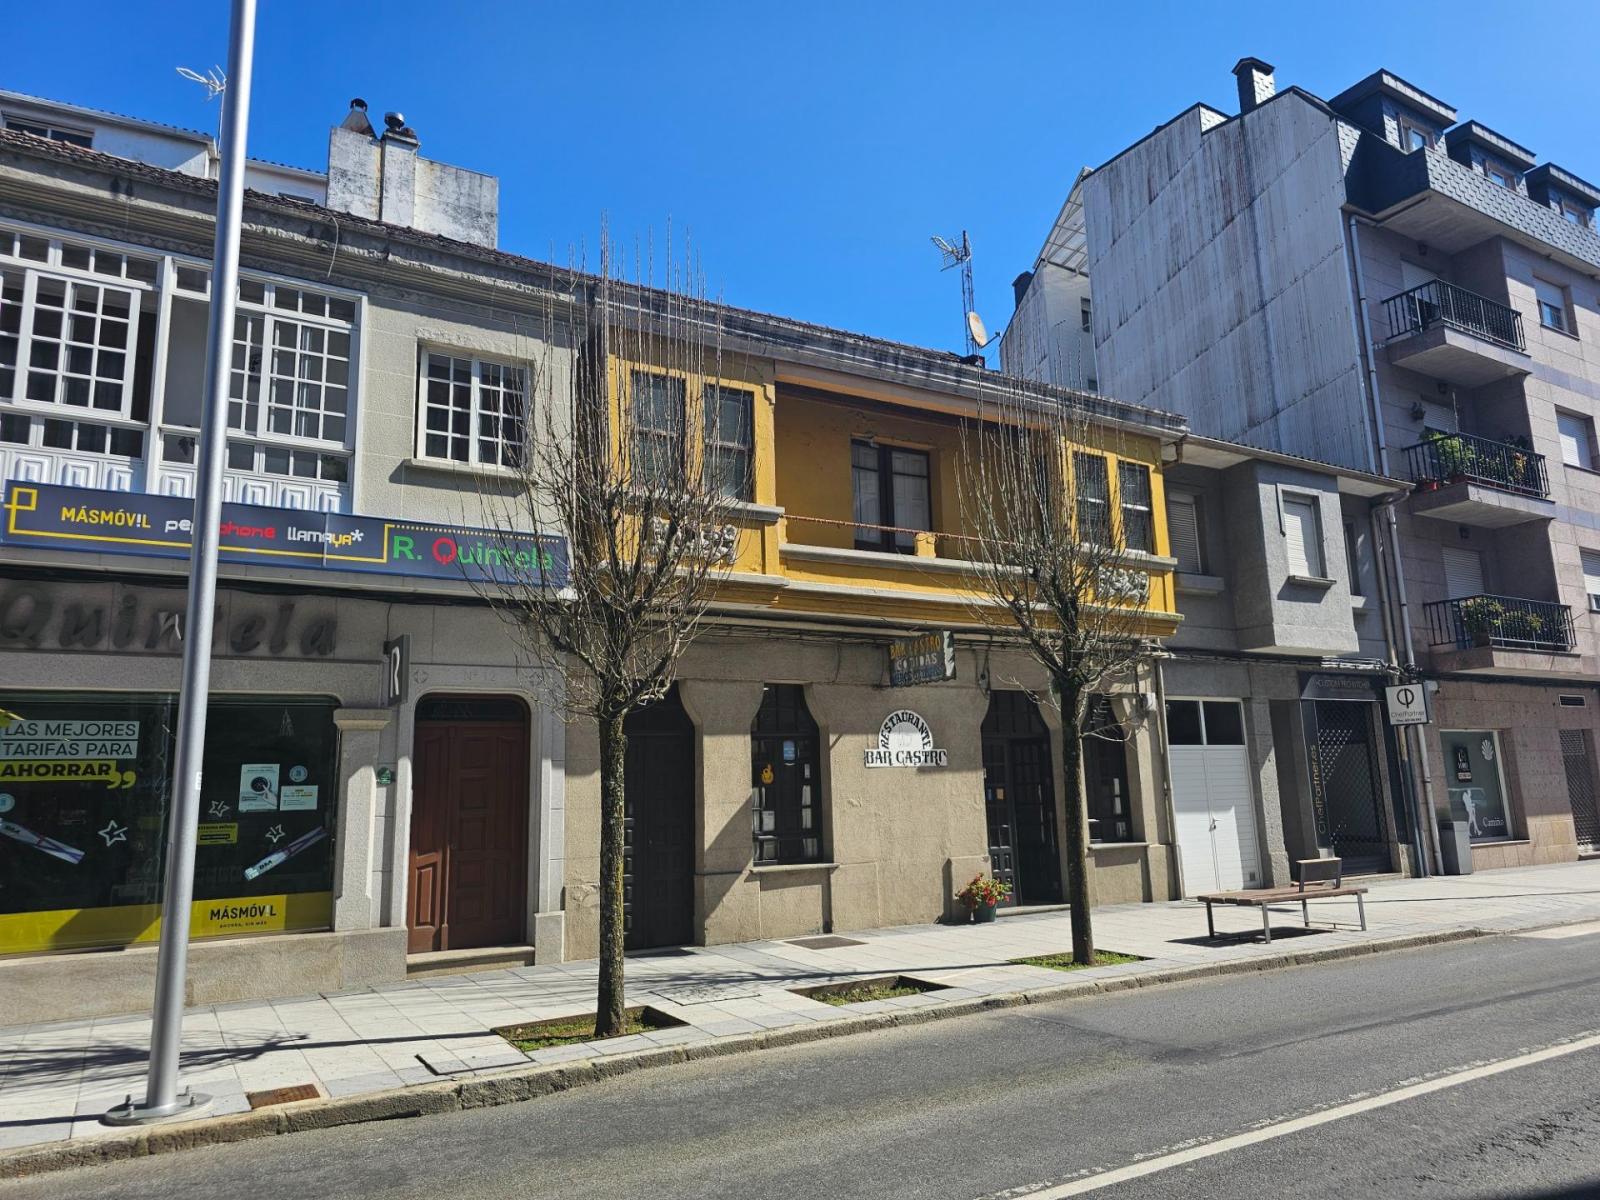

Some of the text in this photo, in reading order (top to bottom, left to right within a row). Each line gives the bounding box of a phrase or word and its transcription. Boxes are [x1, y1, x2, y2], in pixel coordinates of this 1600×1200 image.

[392, 535, 553, 570] R. Quintela
[0, 590, 337, 655] Quinela
[4, 722, 136, 737] LAS MEJORES
[881, 711, 932, 749] RESTAURANTE
[2, 742, 133, 756] TARIFAS PARA
[866, 750, 893, 766] BAR
[0, 763, 112, 777] AHORRAR
[1310, 744, 1327, 834] ChefPartner.es
